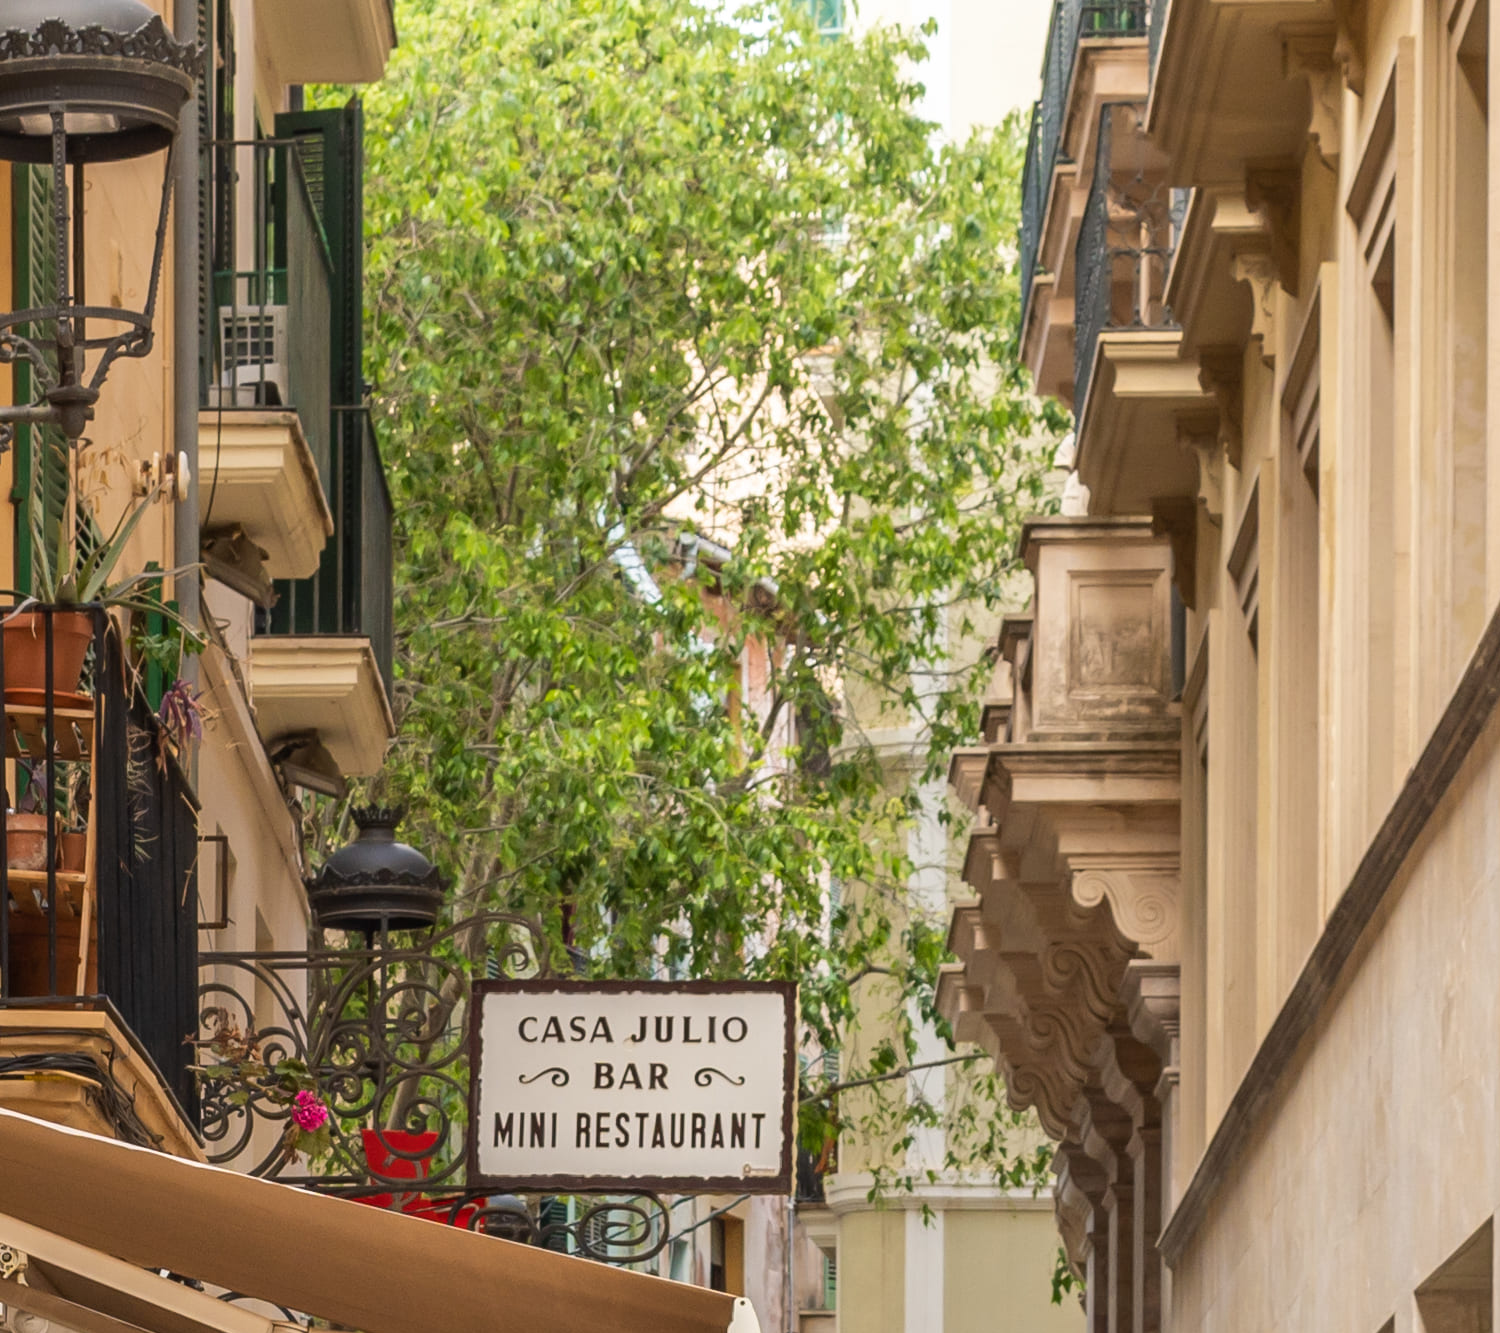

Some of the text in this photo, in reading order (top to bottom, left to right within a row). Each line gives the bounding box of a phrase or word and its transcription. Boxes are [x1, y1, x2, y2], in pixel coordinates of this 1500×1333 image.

[518, 1016, 748, 1043] CASA JULIO
[594, 1062, 668, 1090] BAR
[493, 1112, 766, 1149] MINI RESTAURANT
